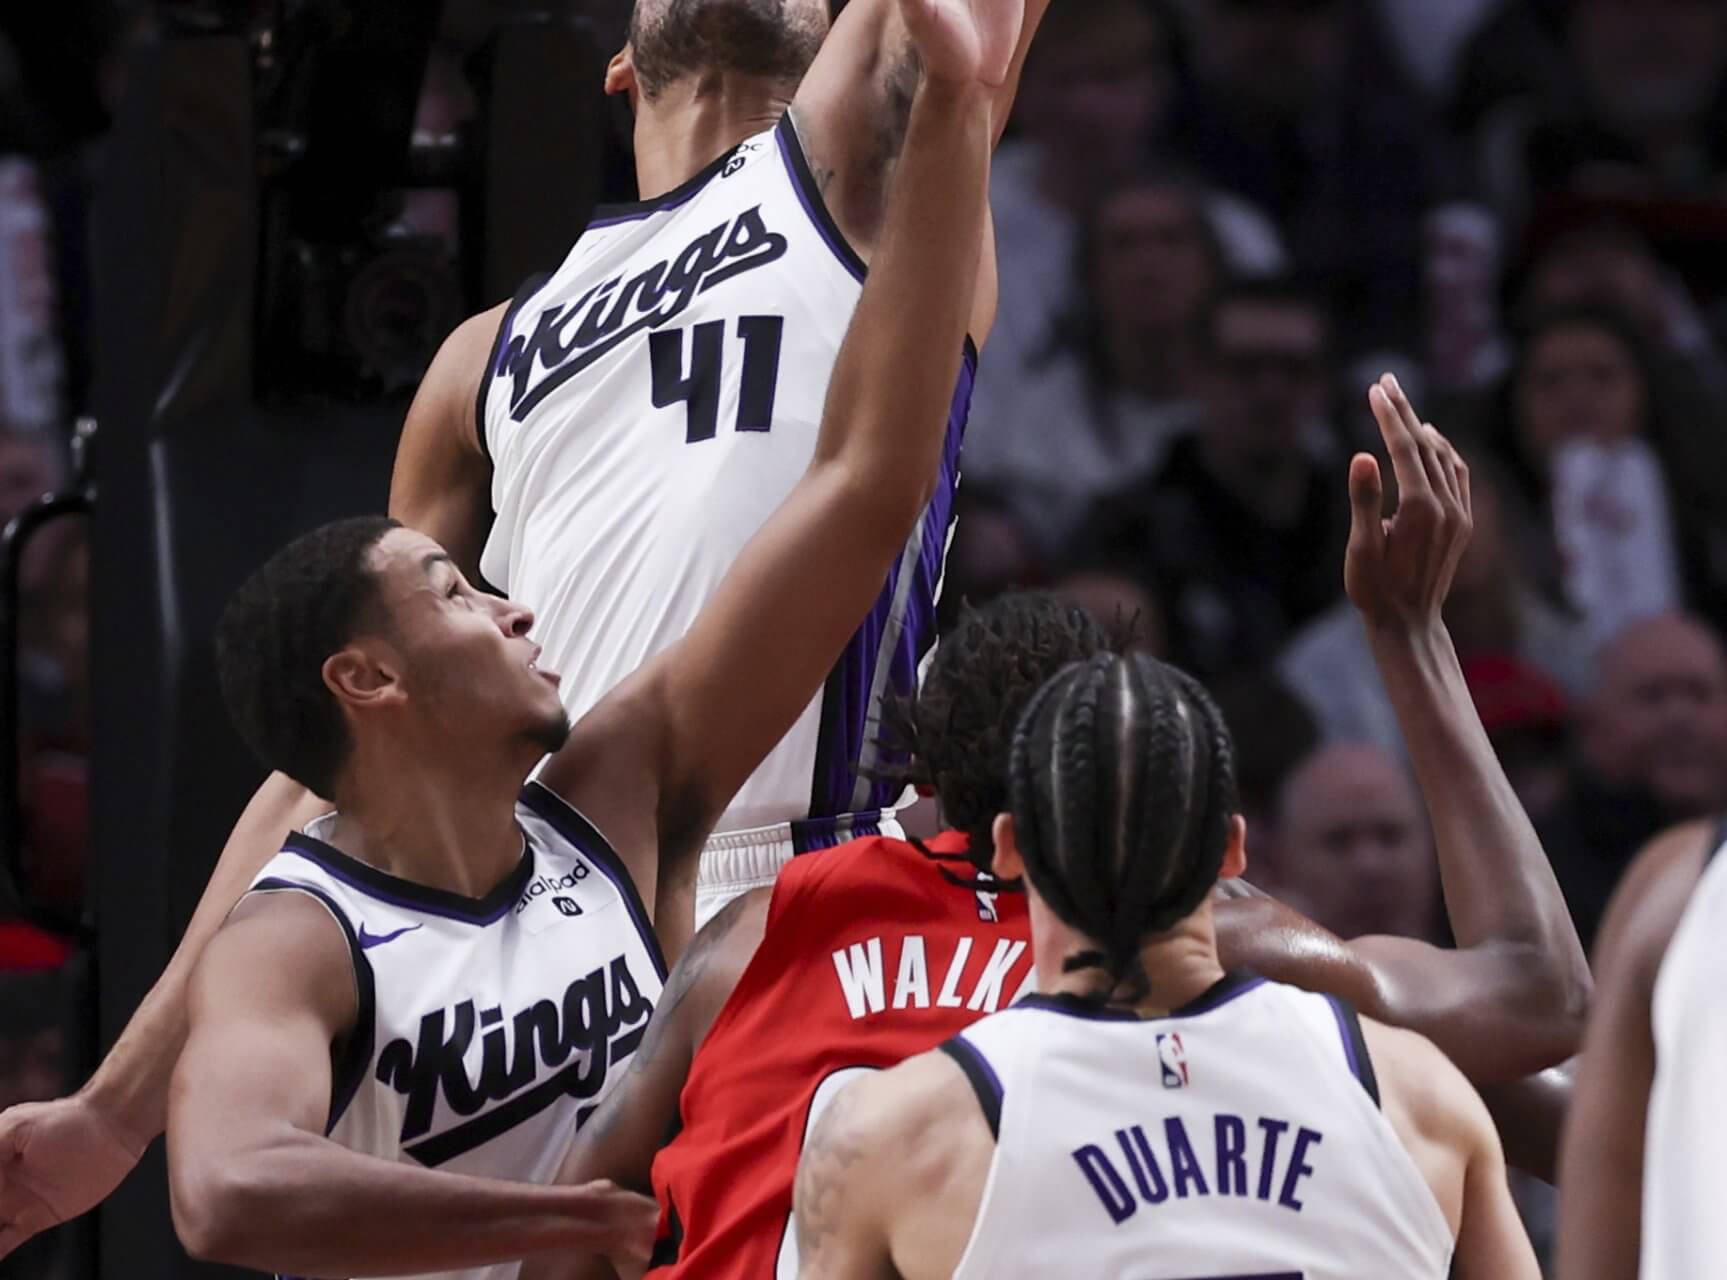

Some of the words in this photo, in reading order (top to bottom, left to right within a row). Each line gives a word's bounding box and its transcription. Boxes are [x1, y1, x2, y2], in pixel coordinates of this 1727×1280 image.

[497, 204, 788, 423] Kings
[649, 315, 784, 444] 41
[831, 935, 1037, 1020] WALK
[375, 954, 654, 1168] Kings
[1072, 1113, 1323, 1226] DUARTE
